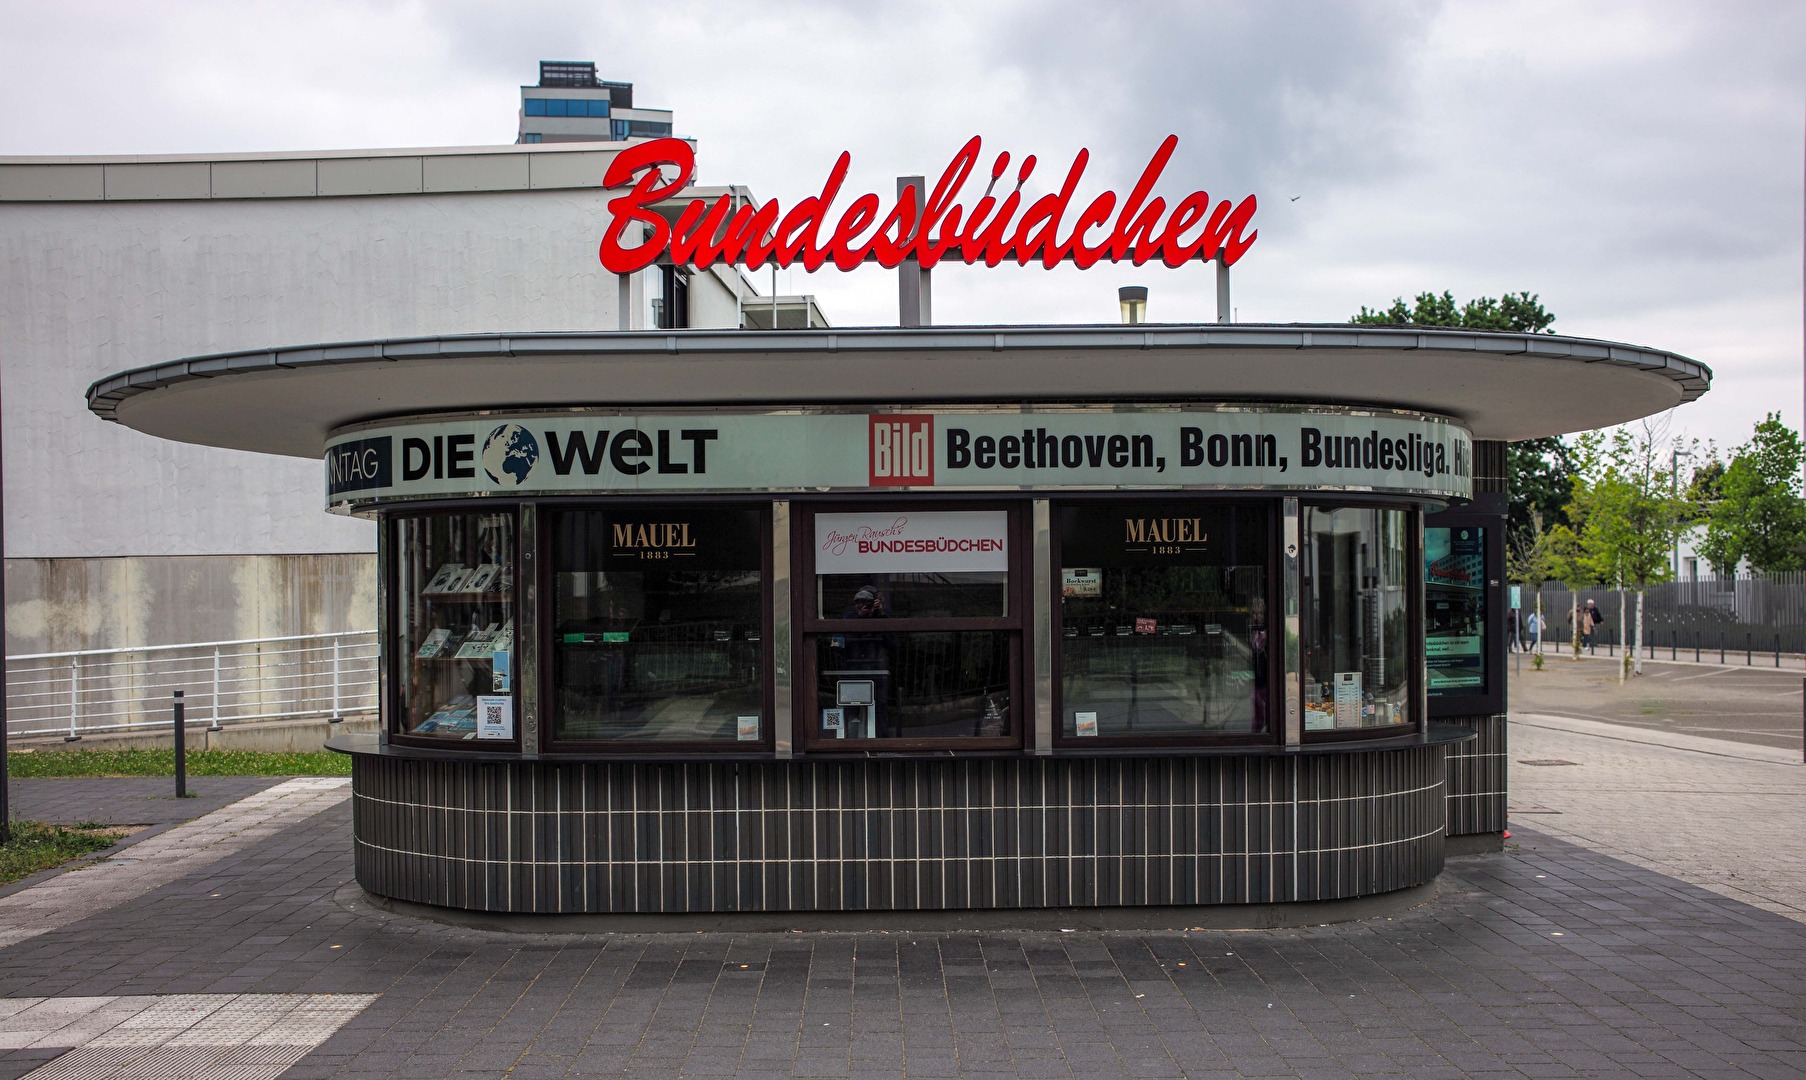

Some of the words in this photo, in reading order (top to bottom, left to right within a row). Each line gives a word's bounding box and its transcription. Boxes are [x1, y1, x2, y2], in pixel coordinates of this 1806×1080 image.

[599, 135, 1258, 273] Bundesbüdchen
[402, 434, 476, 481] DIE
[873, 422, 929, 478] Bild
[946, 428, 1166, 473] Beethoven,
[1180, 427, 1288, 472] Bonn,
[1300, 427, 1450, 478] Bundesliga.
[612, 523, 696, 548] MAUEL
[822, 529, 858, 556] Jürgen
[857, 516, 908, 542] Rausch's
[858, 536, 1003, 554] BUNDESBÜDCHEN
[1125, 518, 1207, 543] MAUEL
[639, 550, 669, 560] 1883
[1151, 545, 1181, 555] 1883
